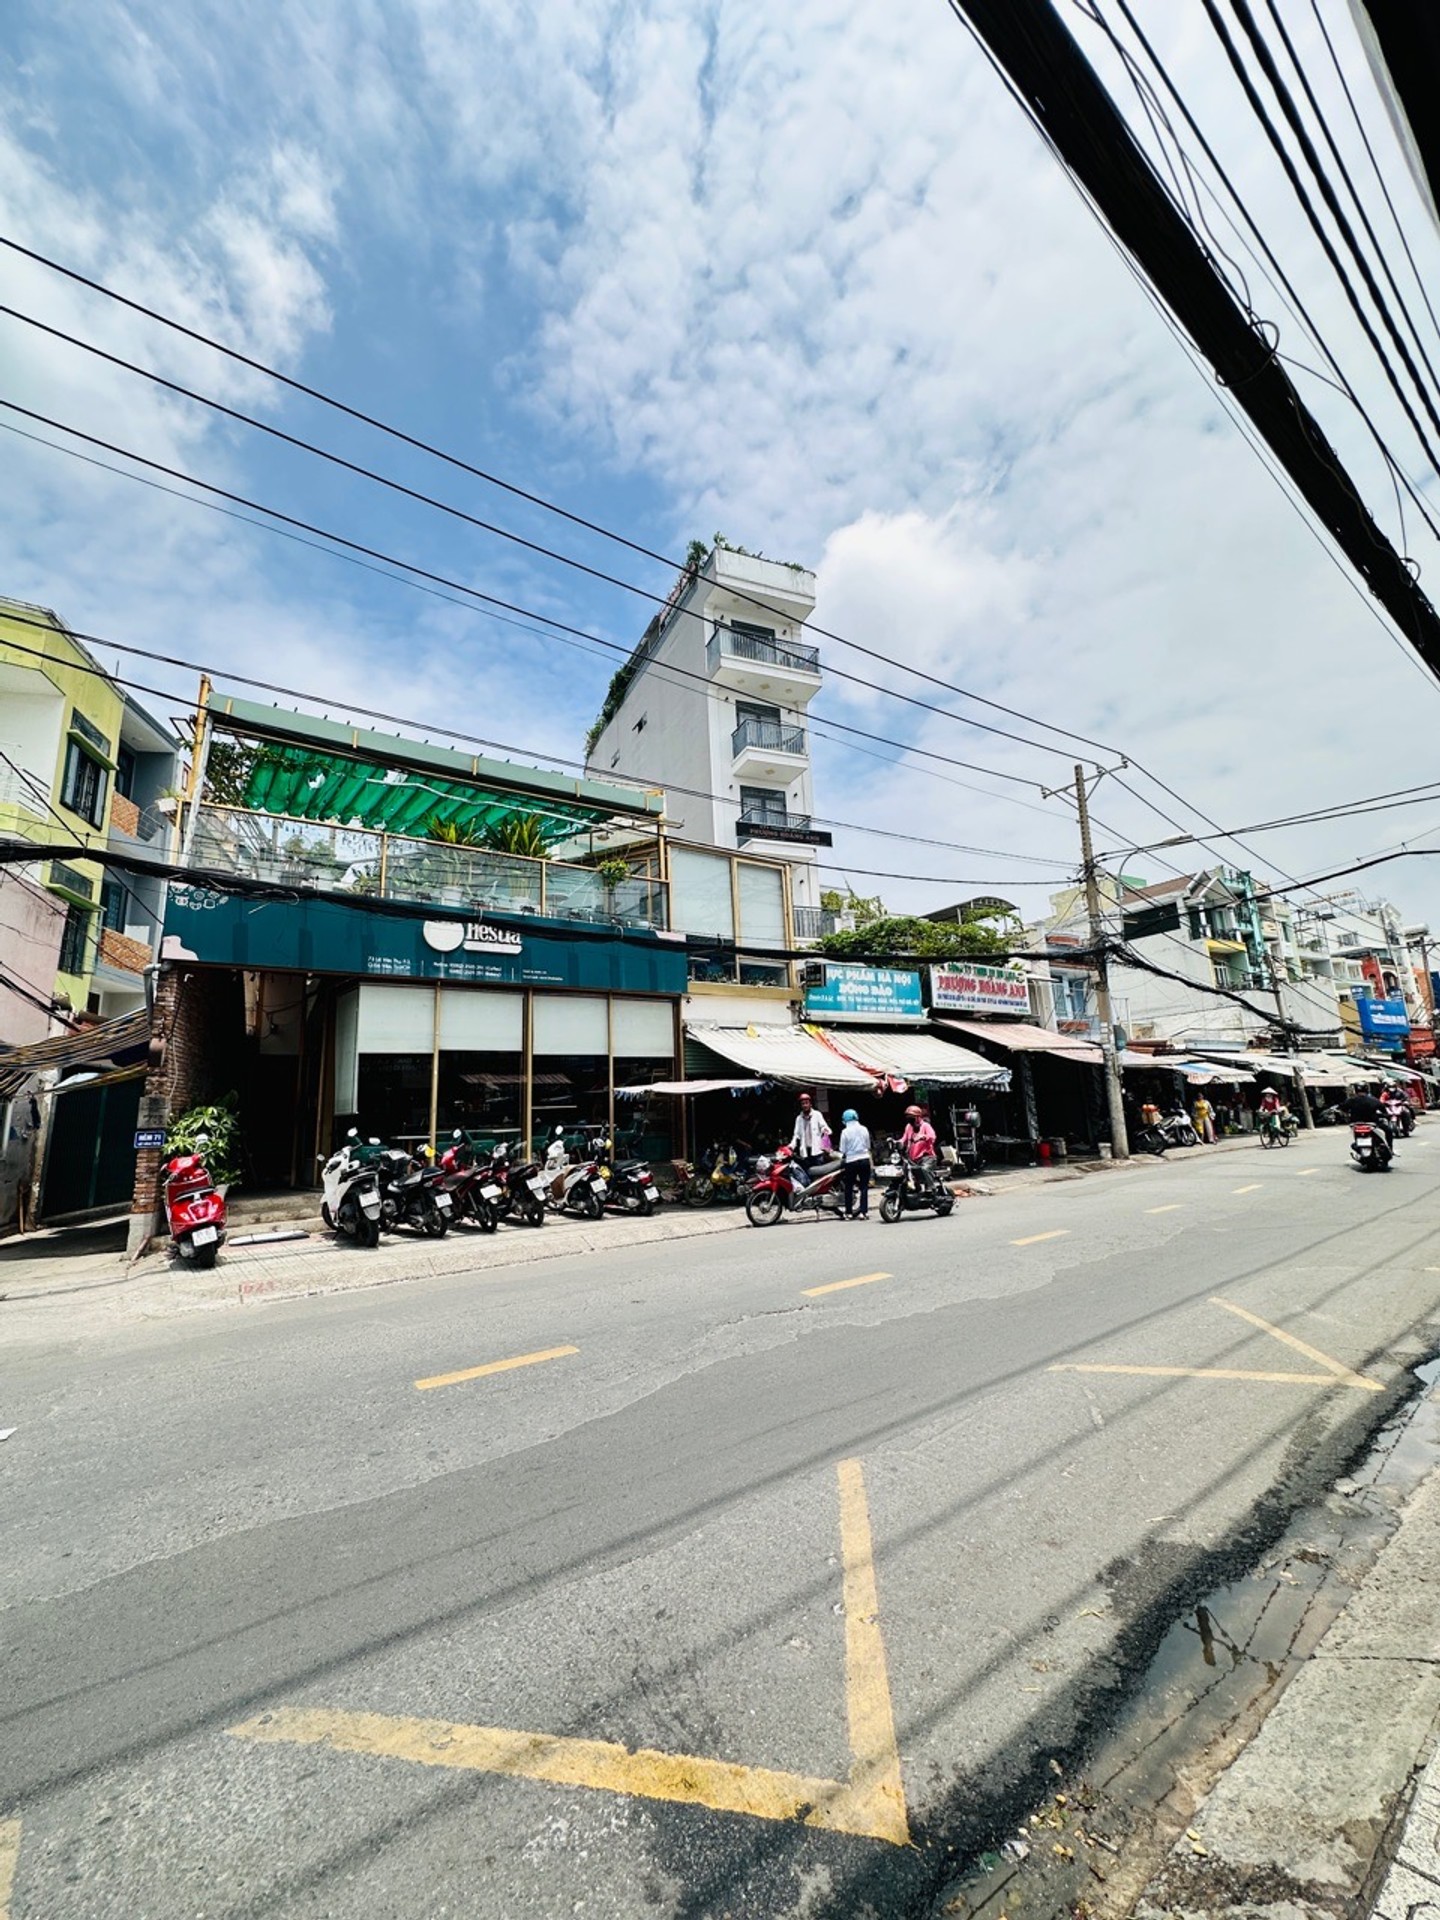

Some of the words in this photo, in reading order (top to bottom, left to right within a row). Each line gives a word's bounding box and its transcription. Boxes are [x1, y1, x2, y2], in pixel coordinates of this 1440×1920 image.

[937, 975, 976, 994] PHƯỢNG
[978, 977, 1008, 995] HOÀNG
[1008, 983, 1027, 998] ANH
